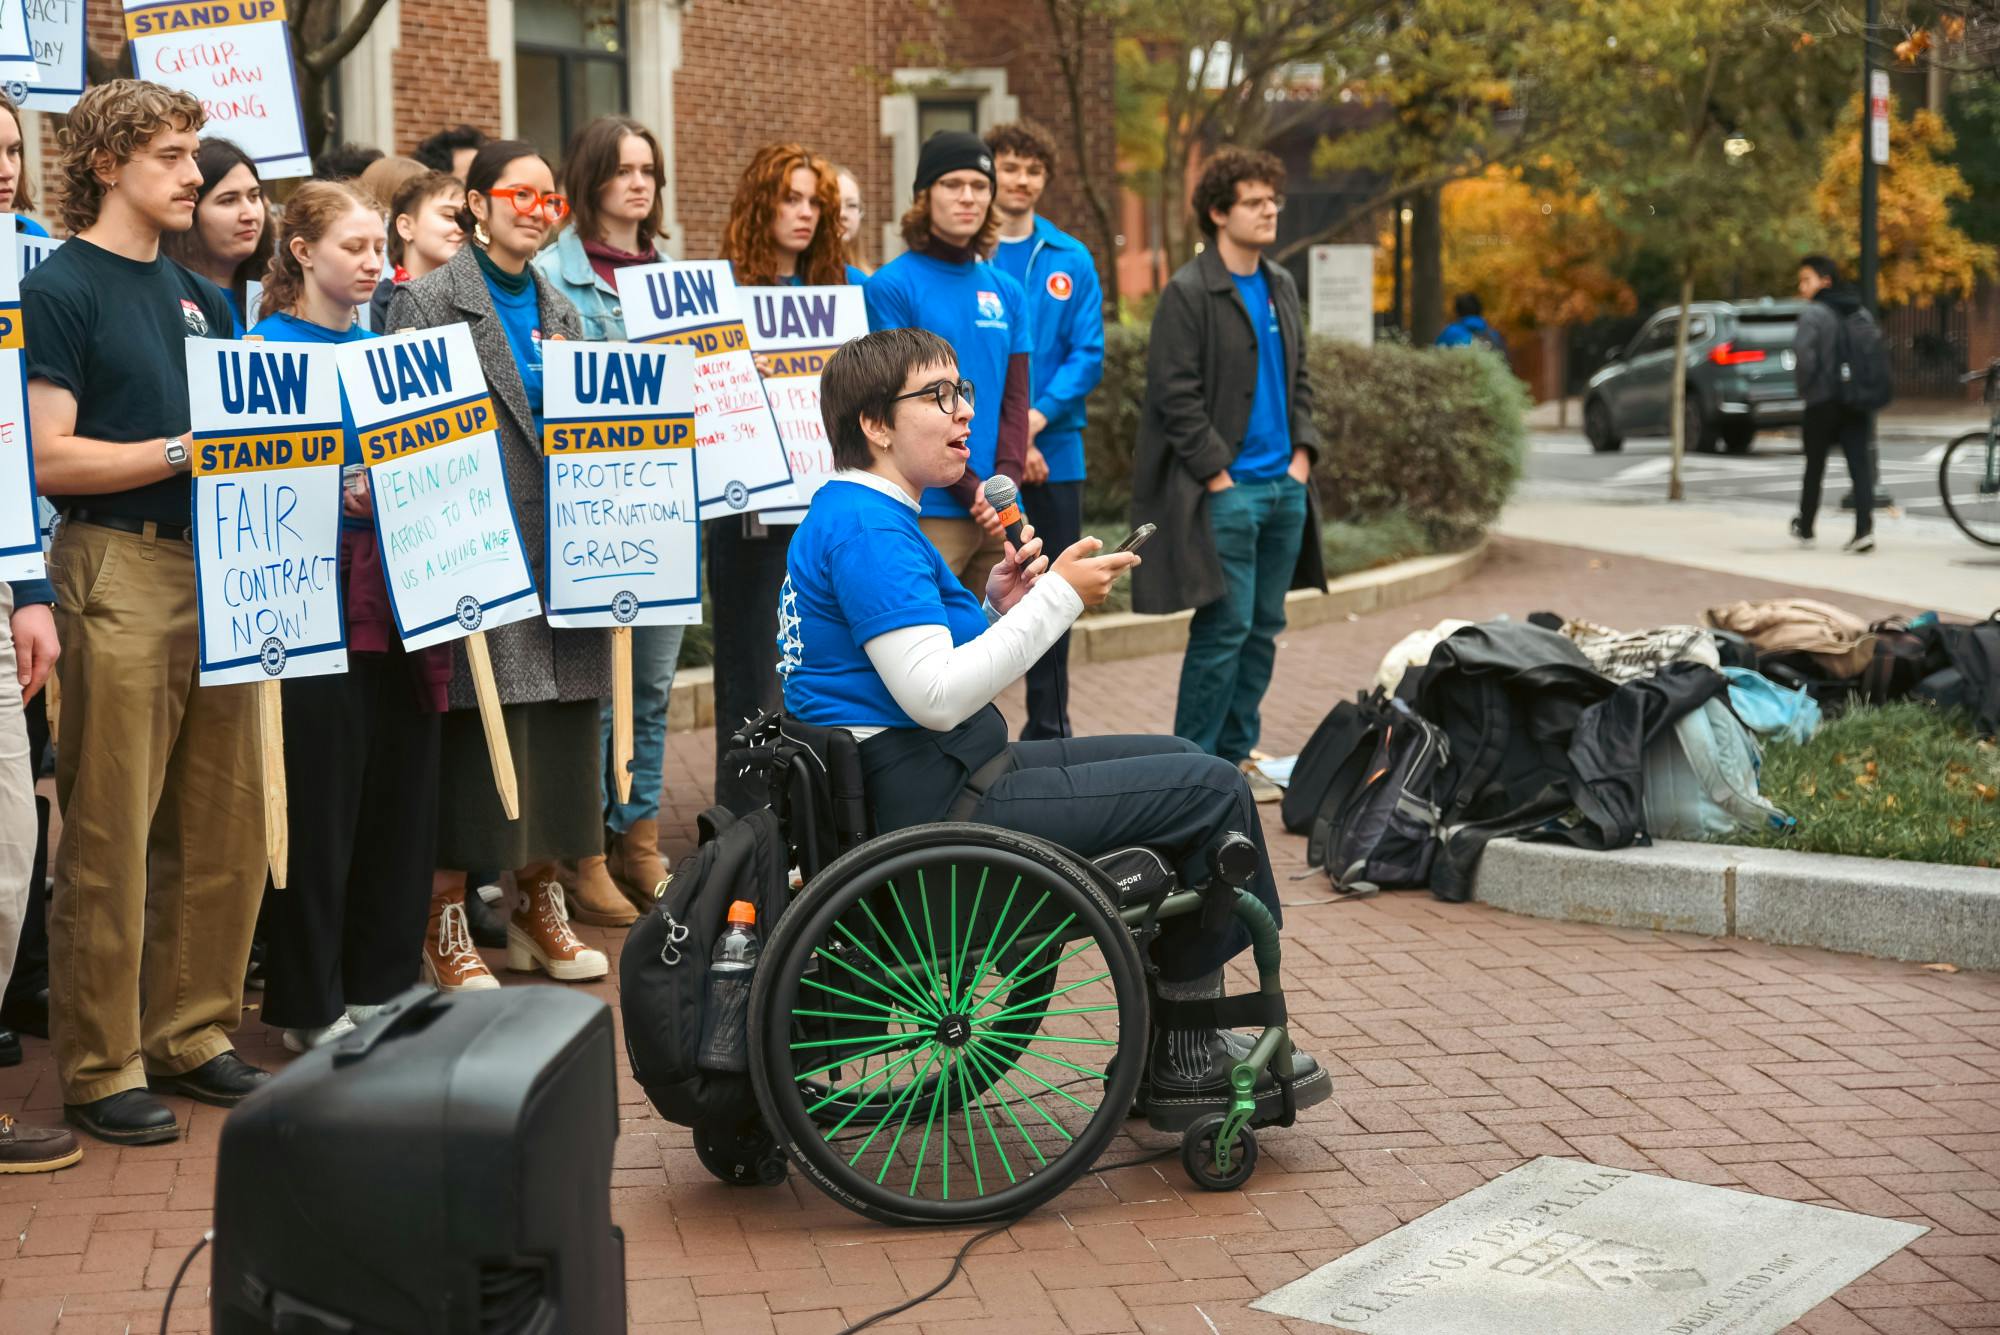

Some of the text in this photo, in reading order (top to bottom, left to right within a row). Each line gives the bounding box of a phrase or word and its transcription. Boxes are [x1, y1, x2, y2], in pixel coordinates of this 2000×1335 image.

[134, 0, 276, 33] STAND UP
[212, 66, 263, 88] UAW
[200, 95, 268, 121] RONG
[645, 269, 720, 320] UAW
[754, 294, 837, 338] UAW
[722, 329, 744, 348] UP
[217, 350, 309, 415] UAW
[365, 337, 453, 405] UAW
[574, 351, 667, 405] UAW
[201, 435, 337, 472] STAND UP
[368, 405, 488, 460] STAND UP
[552, 424, 688, 451] STAND UP
[380, 449, 480, 513] PENN CAN
[556, 461, 678, 489] PROTECT
[216, 483, 304, 559] FAIR
[441, 501, 461, 528] TO
[469, 487, 493, 517] PAY
[556, 499, 699, 528] INTERNATIONAL
[402, 528, 511, 591] US A LIVING WAGE
[562, 539, 659, 569] GRADS
[224, 555, 336, 607] CONTRACT
[232, 599, 308, 652] NOW!
[1116, 873, 1142, 887] MFORT
[788, 1141, 868, 1209] SCHWALBE
[1327, 1272, 1443, 1323] CLASS
[1427, 1246, 1480, 1270] OF
[1528, 1170, 1632, 1217] PLAZA
[1664, 1273, 1773, 1335] DEDICATED
